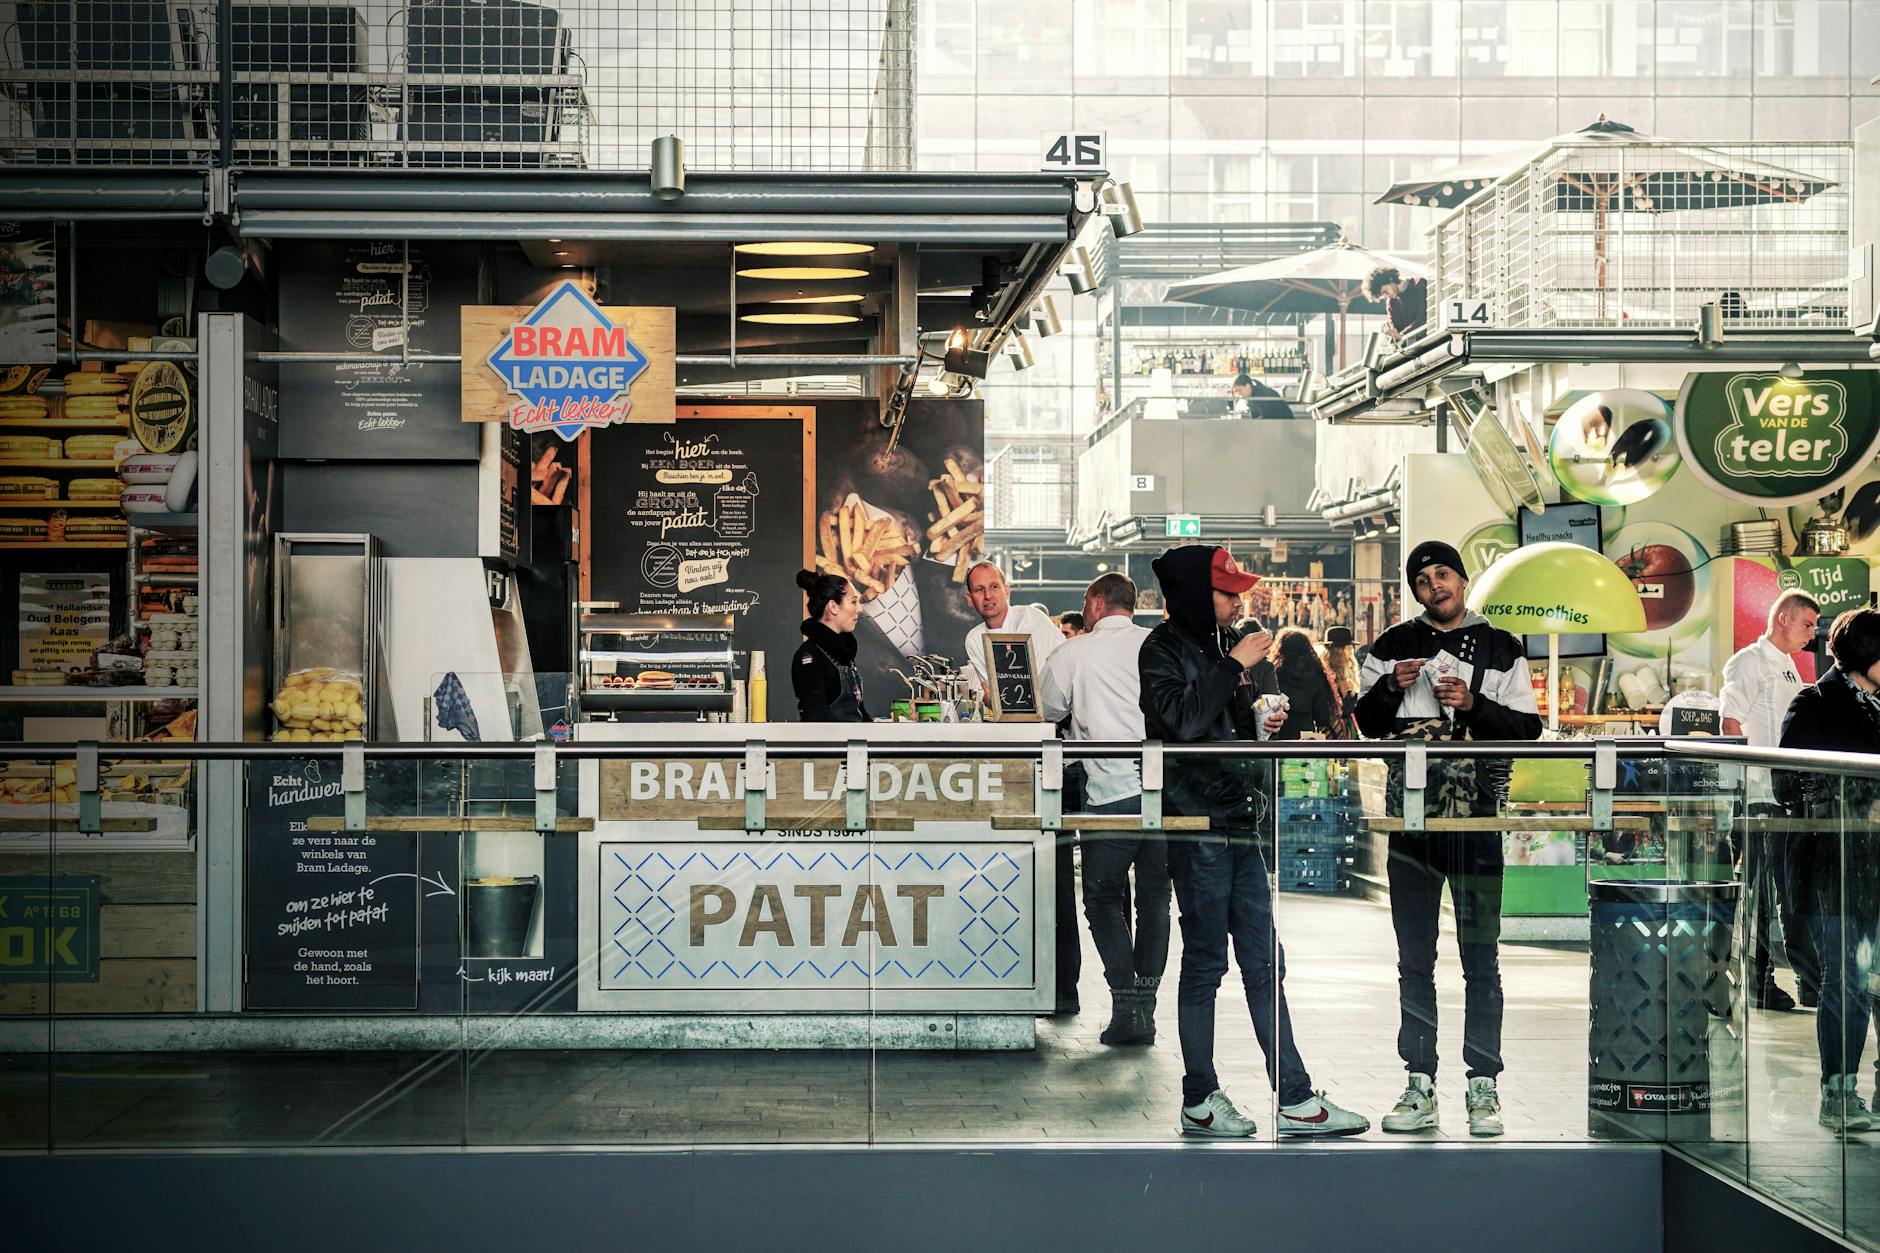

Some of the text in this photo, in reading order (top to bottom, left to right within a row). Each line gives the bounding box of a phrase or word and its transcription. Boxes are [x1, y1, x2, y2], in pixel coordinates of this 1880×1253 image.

[1046, 135, 1100, 166] 46
[370, 242, 396, 256] hier
[360, 290, 395, 312] patat
[1450, 302, 1488, 324] 14
[513, 326, 626, 358] BRAM
[512, 366, 625, 390] LADAGE
[1743, 388, 1830, 416] Vers
[512, 396, 628, 426] Echt lekker!
[358, 417, 405, 430] Echt lekker!
[1760, 417, 1808, 428] VAN DE
[674, 440, 710, 460] hier
[1731, 429, 1831, 462] teler
[1137, 477, 1147, 488] 8
[636, 496, 698, 509] GROND
[660, 506, 709, 539] patat
[1526, 531, 1573, 542] Healthy snacks
[685, 564, 710, 574] Vinden
[712, 561, 723, 572] wij
[700, 571, 716, 581] ook!
[1809, 564, 1843, 590] Tijd
[56, 603, 103, 611] Hollandse
[692, 600, 749, 615] & toewijding
[1482, 604, 1588, 624] verse smoothies
[28, 614, 101, 625] Oud Belegen
[50, 627, 79, 636] Kaas
[1005, 650, 1024, 669] 2
[1681, 711, 1712, 723] SOEP DAG
[272, 775, 303, 787] Echt
[268, 781, 344, 808] handwer
[290, 821, 308, 832] Elk
[292, 835, 376, 846] ze vers naar de
[301, 849, 367, 860] winkels van
[296, 862, 372, 875] Bram Ladage.
[286, 886, 374, 914] om ze hier te
[278, 902, 389, 936] snijden tot patat
[689, 884, 945, 947] PATAT
[298, 947, 368, 958] Gewoon met
[294, 962, 372, 973] de hand, zoals
[306, 975, 359, 985] het hoort.
[488, 966, 555, 985] kijk maar!
